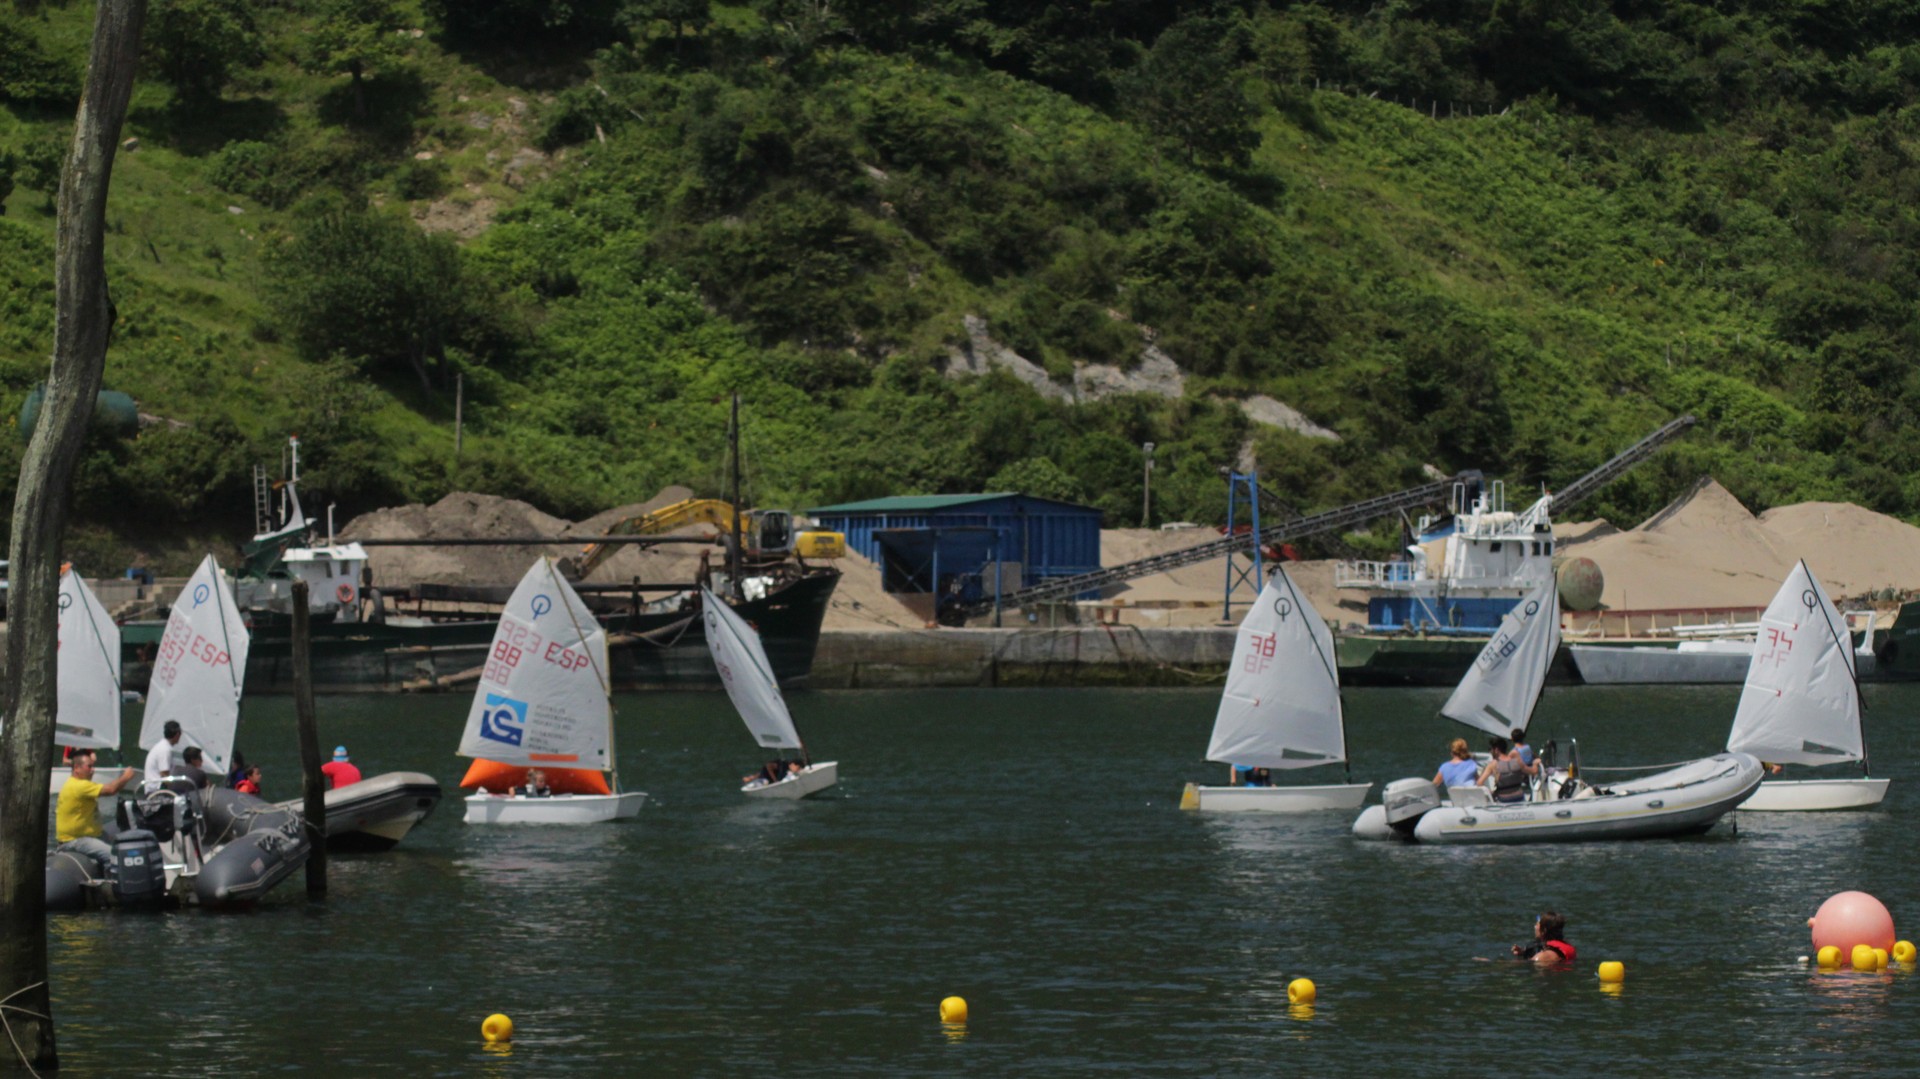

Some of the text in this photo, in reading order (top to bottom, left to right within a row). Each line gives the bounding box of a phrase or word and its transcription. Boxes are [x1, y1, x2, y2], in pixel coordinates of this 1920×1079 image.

[190, 634, 231, 668] ESP
[494, 640, 522, 667] 88
[544, 641, 589, 672] ESP
